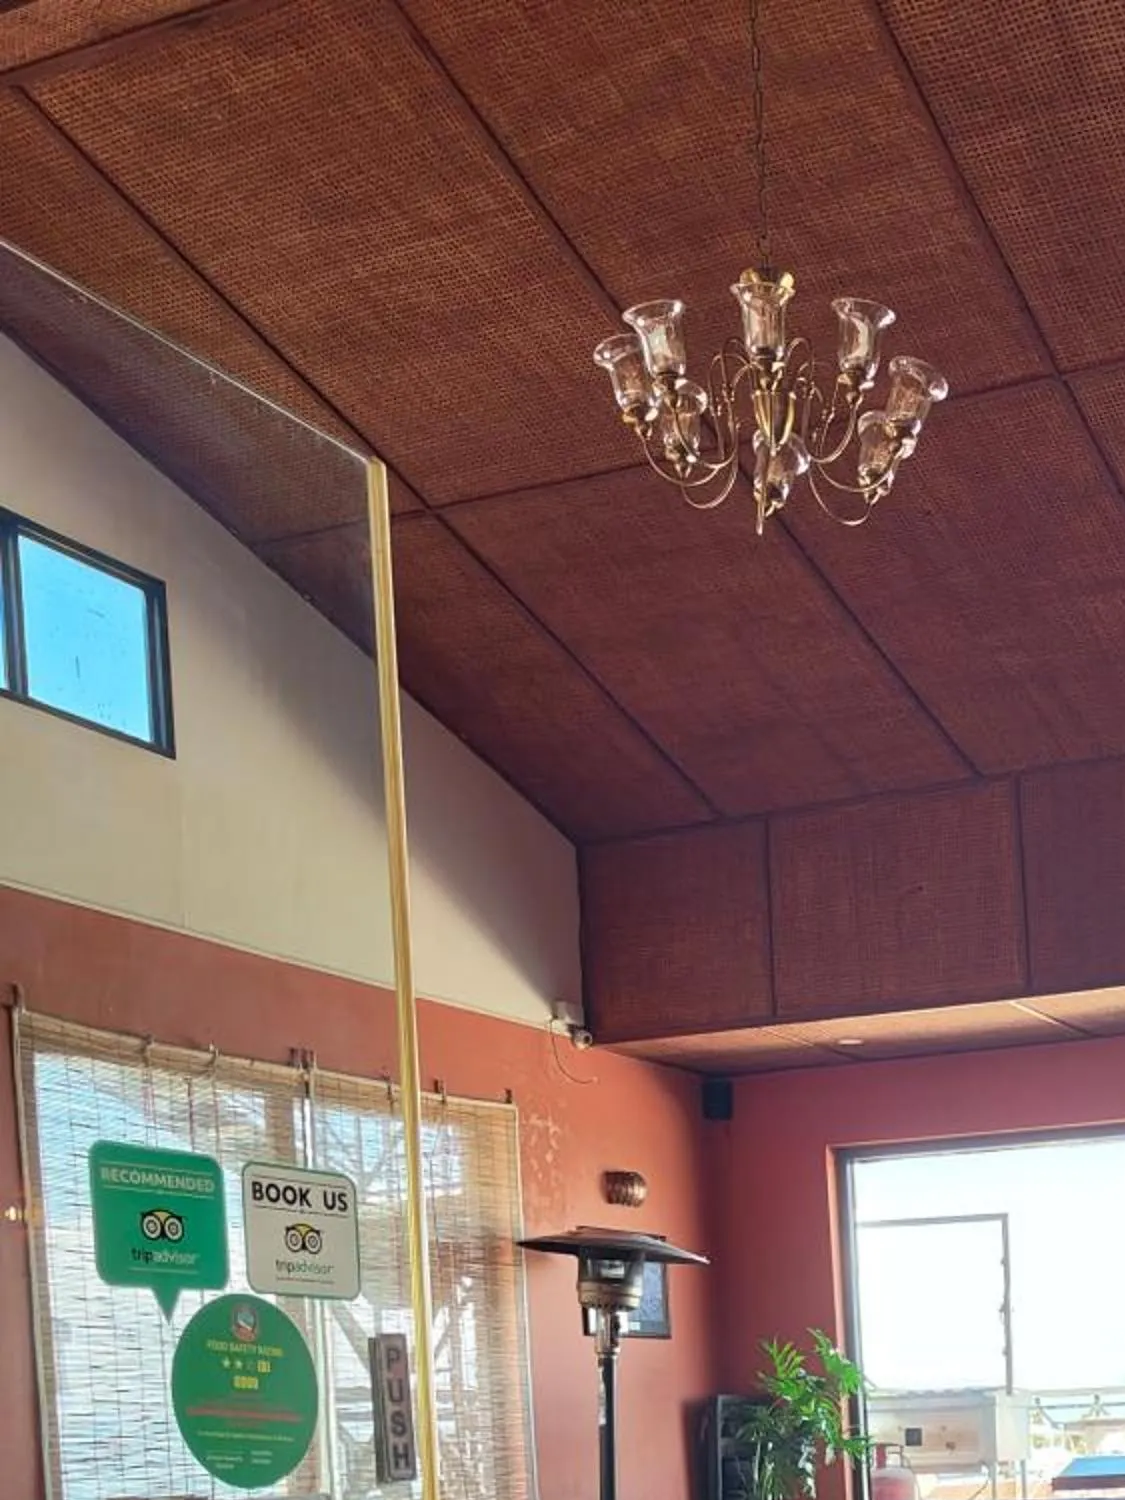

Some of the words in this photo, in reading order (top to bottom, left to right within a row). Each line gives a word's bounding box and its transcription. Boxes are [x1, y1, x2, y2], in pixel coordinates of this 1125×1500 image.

[101, 1167, 215, 1193] RECOMMENDED
[252, 1181, 312, 1208] BOOK
[323, 1190, 348, 1212] US
[131, 1247, 198, 1265] tripadvisor
[275, 1259, 335, 1275] tripadvisor
[387, 1348, 410, 1469] PUSH
